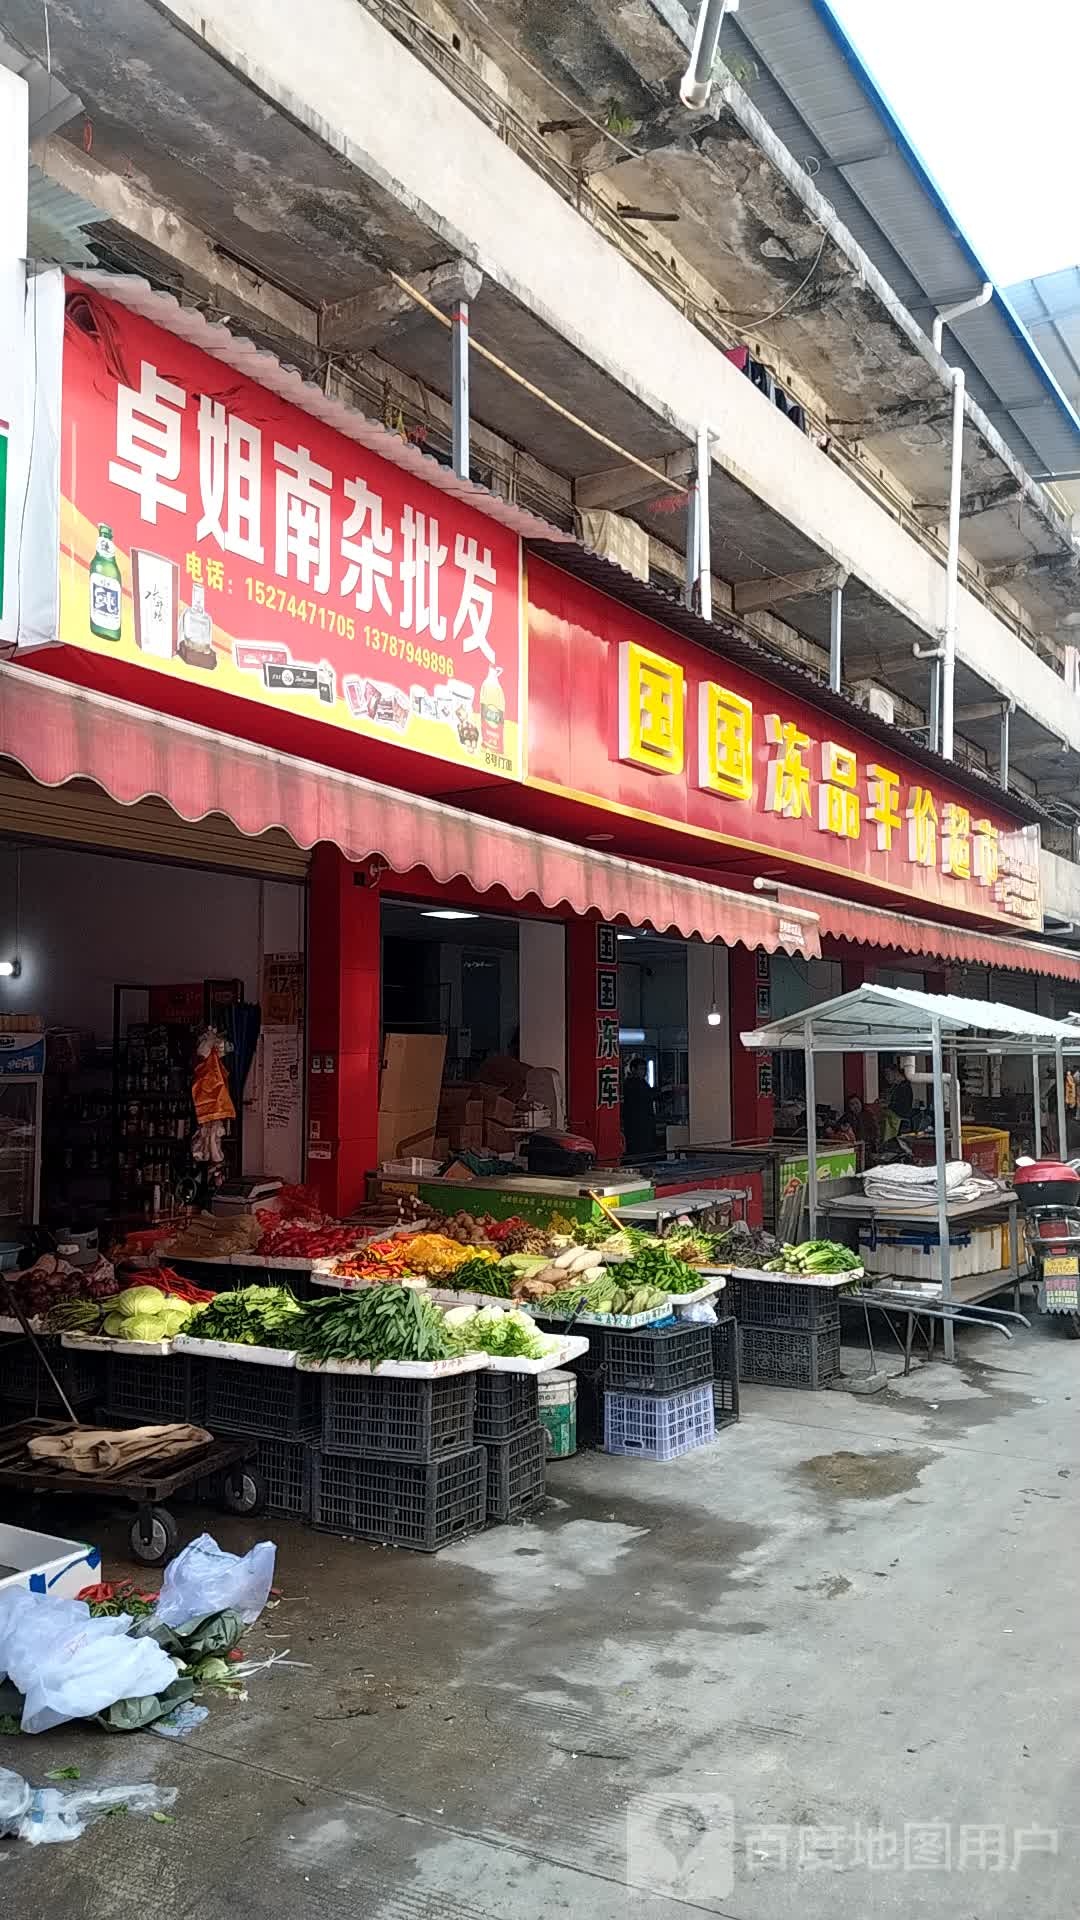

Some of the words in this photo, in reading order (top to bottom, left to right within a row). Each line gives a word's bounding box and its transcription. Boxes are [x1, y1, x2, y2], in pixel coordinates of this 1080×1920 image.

[108, 360, 497, 663] 卓姐南杂批发
[245, 577, 355, 641] 15274471705
[363, 625, 454, 677] 13787949896
[618, 641, 1000, 886] 国国冻品平价超市
[596, 922, 620, 1110] 国国冻库
[756, 949, 774, 1098] 国国库
